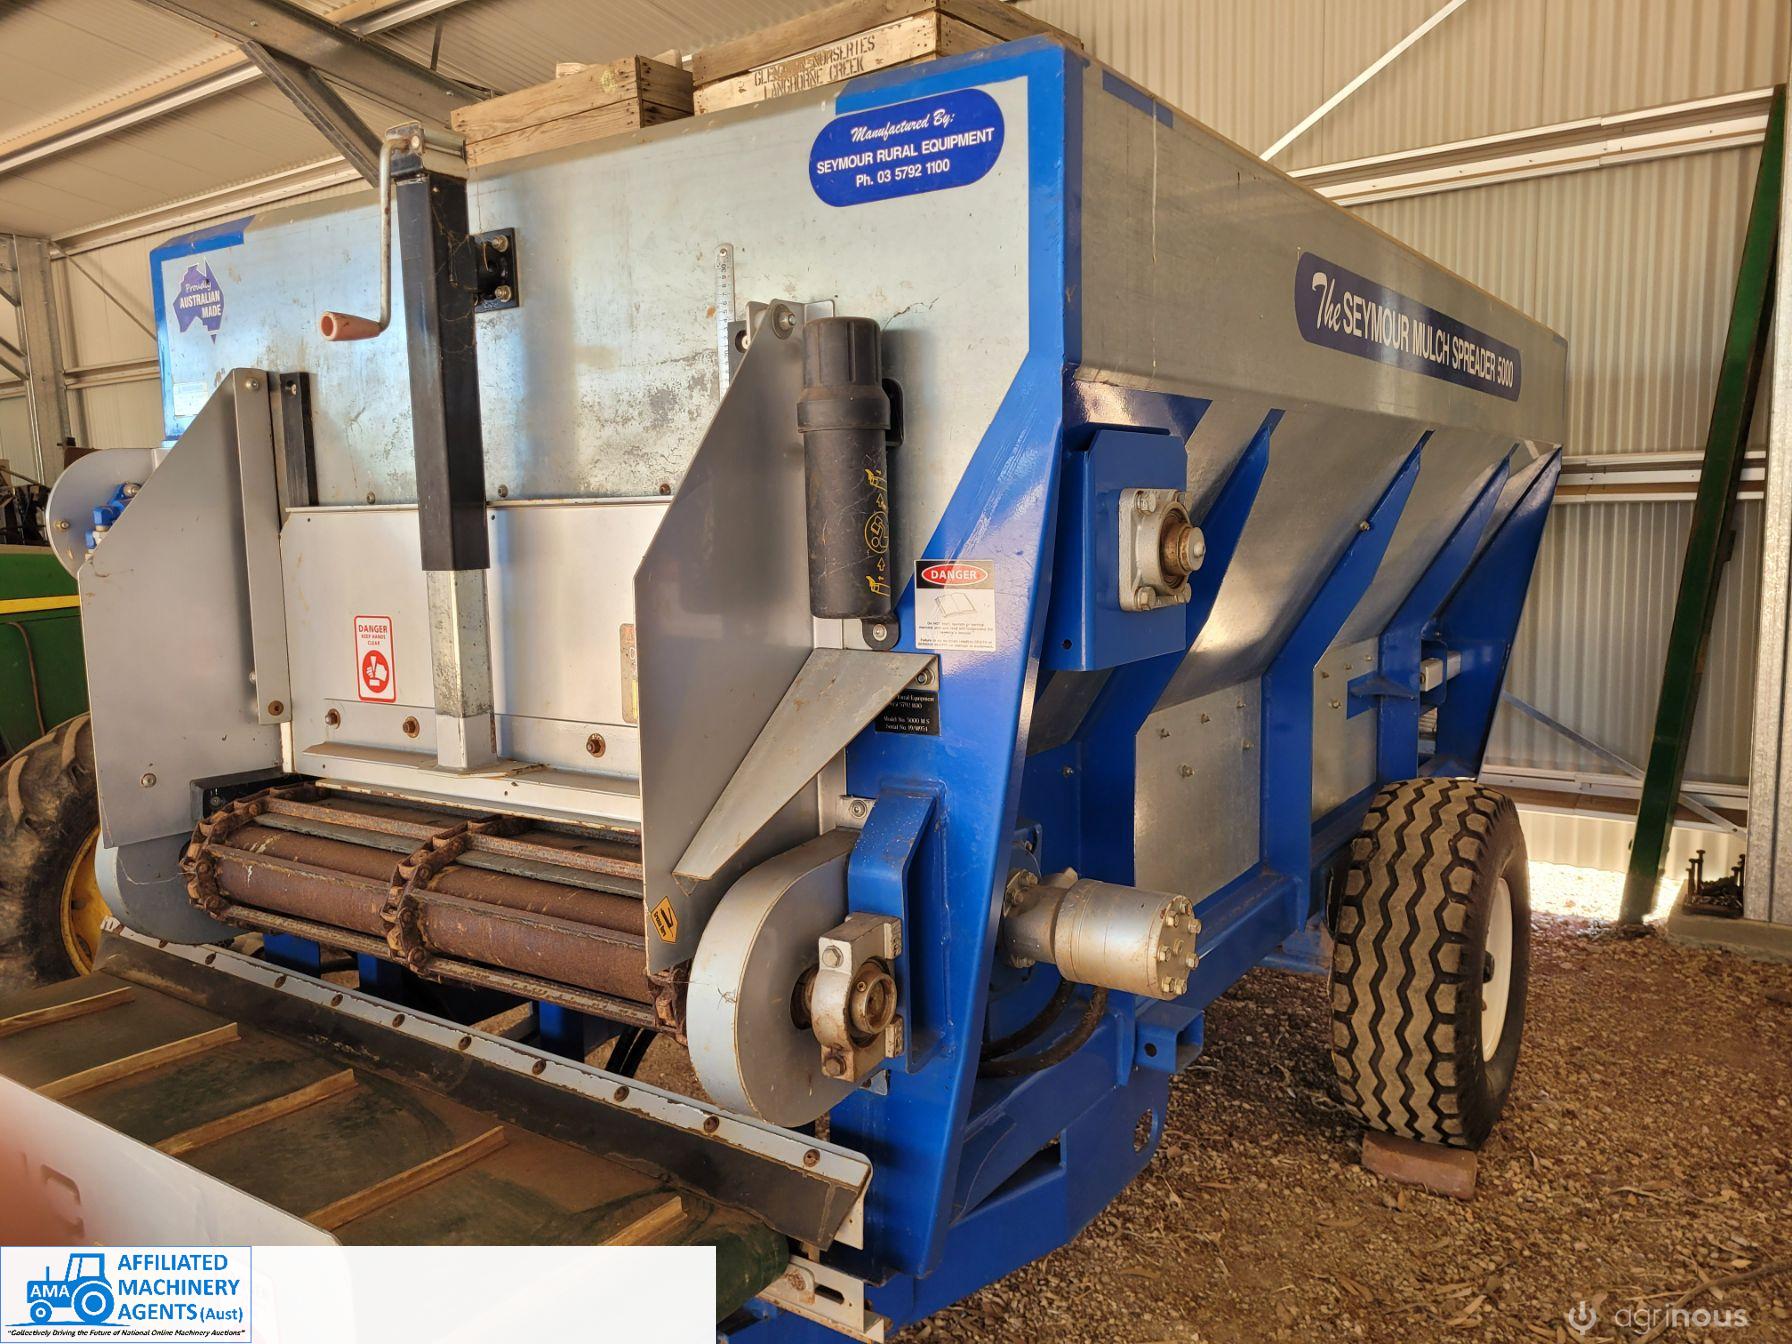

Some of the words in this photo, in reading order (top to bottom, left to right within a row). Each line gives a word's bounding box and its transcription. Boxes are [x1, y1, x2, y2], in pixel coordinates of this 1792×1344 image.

[764, 67, 824, 100] LANGHORNE
[829, 56, 865, 81] CREEK
[851, 115, 930, 143] Manufactured
[933, 108, 956, 131] By:
[816, 151, 874, 175] SEYMOUR
[876, 145, 918, 167] RURAL
[921, 127, 995, 155] EQUIPMENT
[855, 174, 874, 188] Ph.
[877, 171, 892, 184] 03
[895, 165, 922, 180] 5792
[926, 159, 951, 175] 1100
[185, 281, 212, 293] Proudly
[179, 290, 221, 309] AUSTRALIAN
[201, 304, 222, 319] MADE
[1311, 271, 1341, 333] The
[1343, 290, 1410, 353] SEYMOUR
[1412, 319, 1450, 366] MULCH
[1452, 336, 1496, 382] SPREADER
[1497, 355, 1514, 389] 5000
[930, 569, 978, 580] DANGER
[358, 625, 387, 633] DANGER
